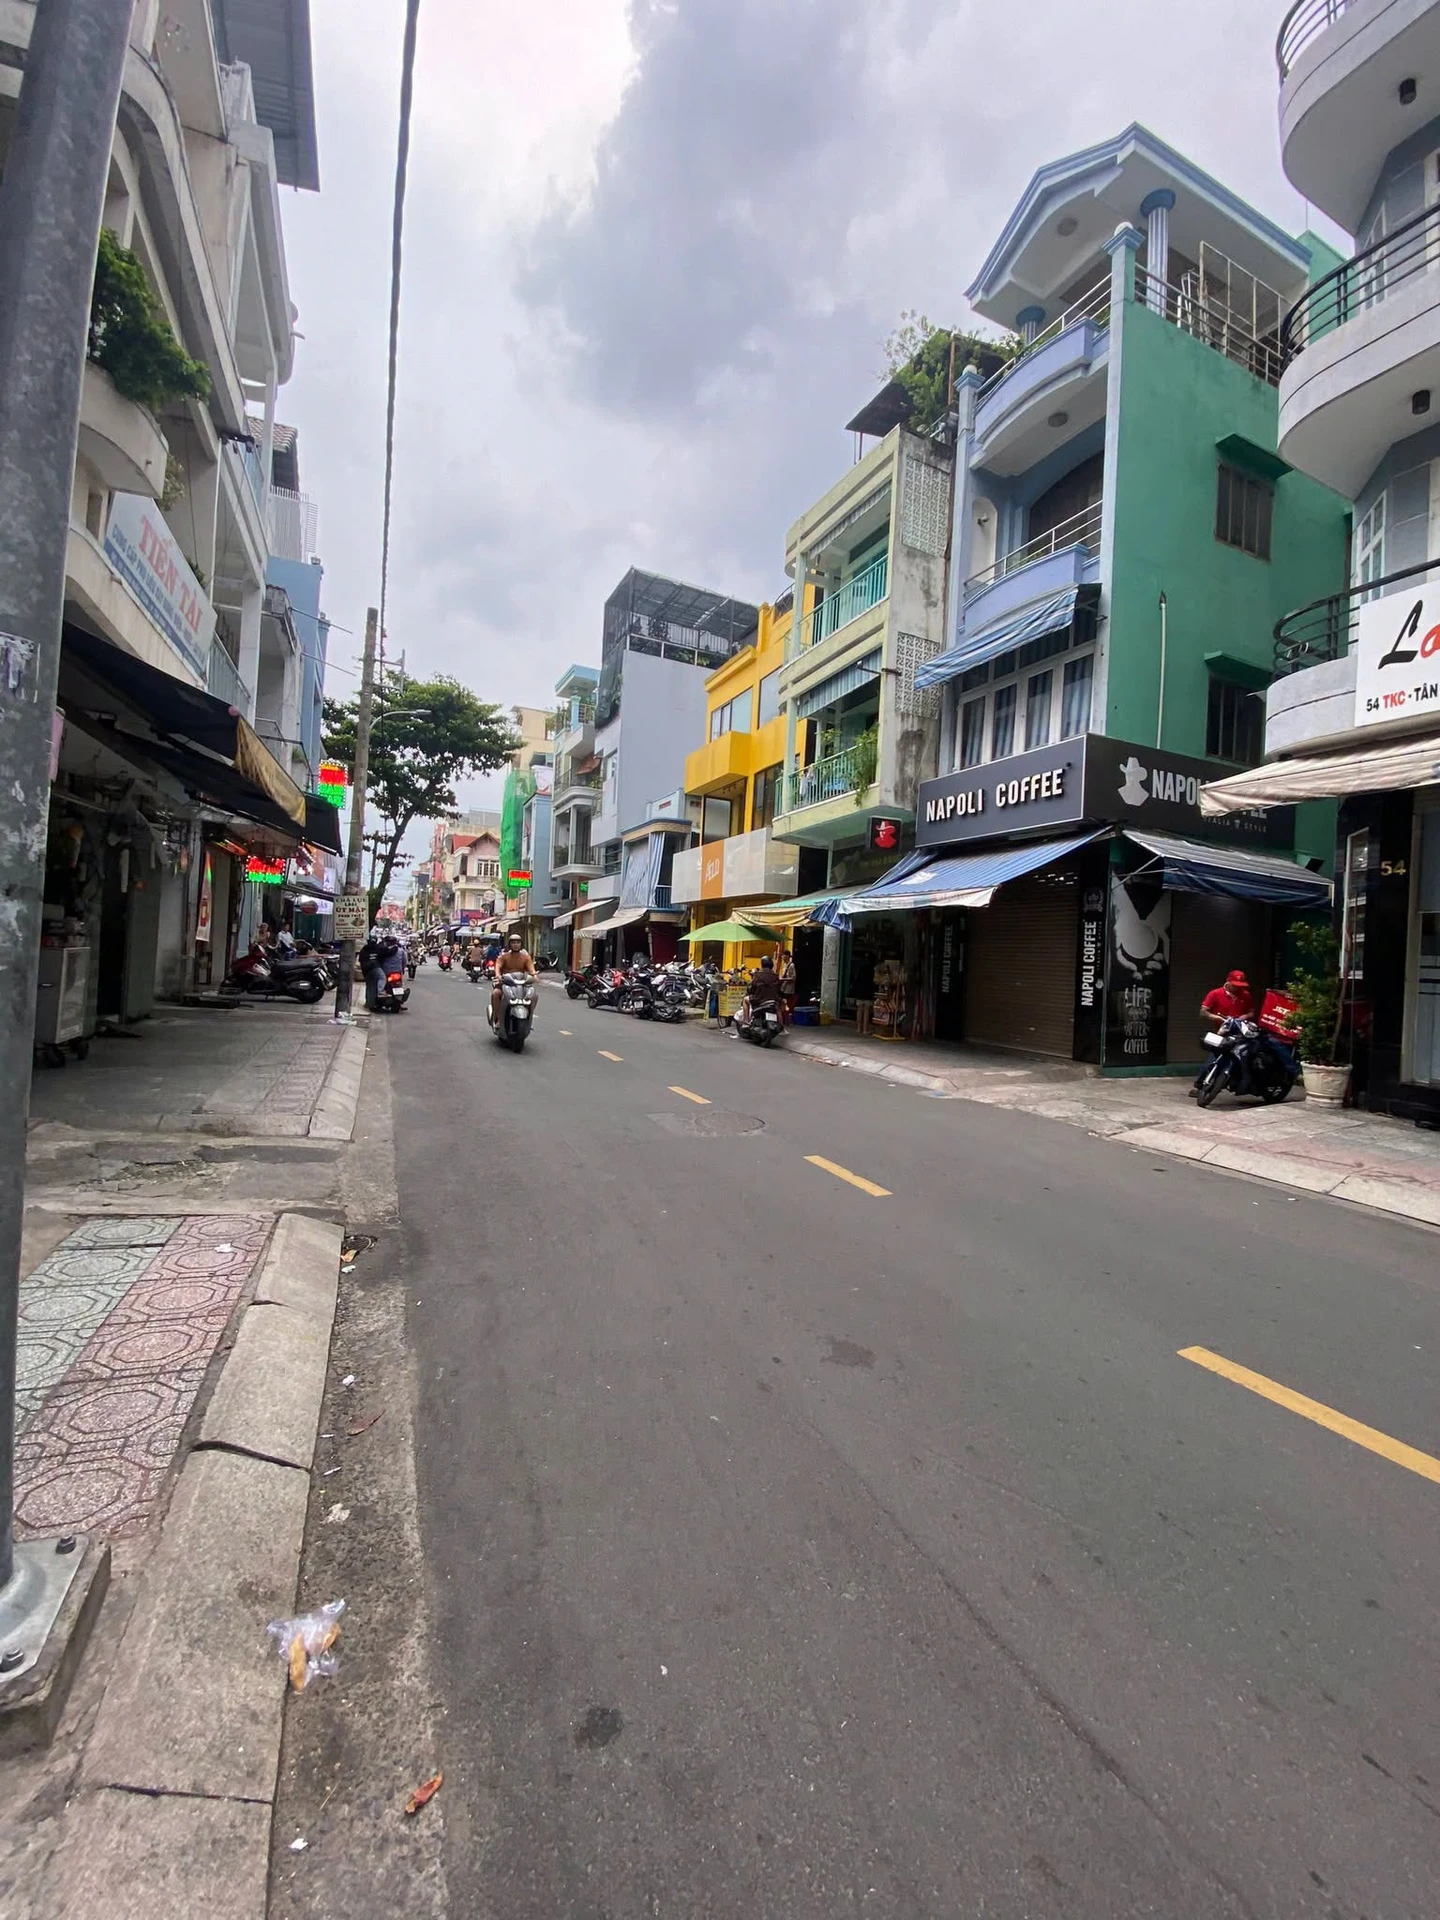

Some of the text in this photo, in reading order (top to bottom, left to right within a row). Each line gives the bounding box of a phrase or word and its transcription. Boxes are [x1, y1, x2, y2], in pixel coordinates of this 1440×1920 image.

[179, 582, 203, 633] TÀI
[1366, 683, 1438, 712] 54 TKC TÂN
[926, 768, 1063, 823] NAPOLI COFFEE
[1381, 861, 1406, 876] 54
[1083, 921, 1097, 963] COFFEE
[1081, 965, 1095, 1006] NAPOLI
